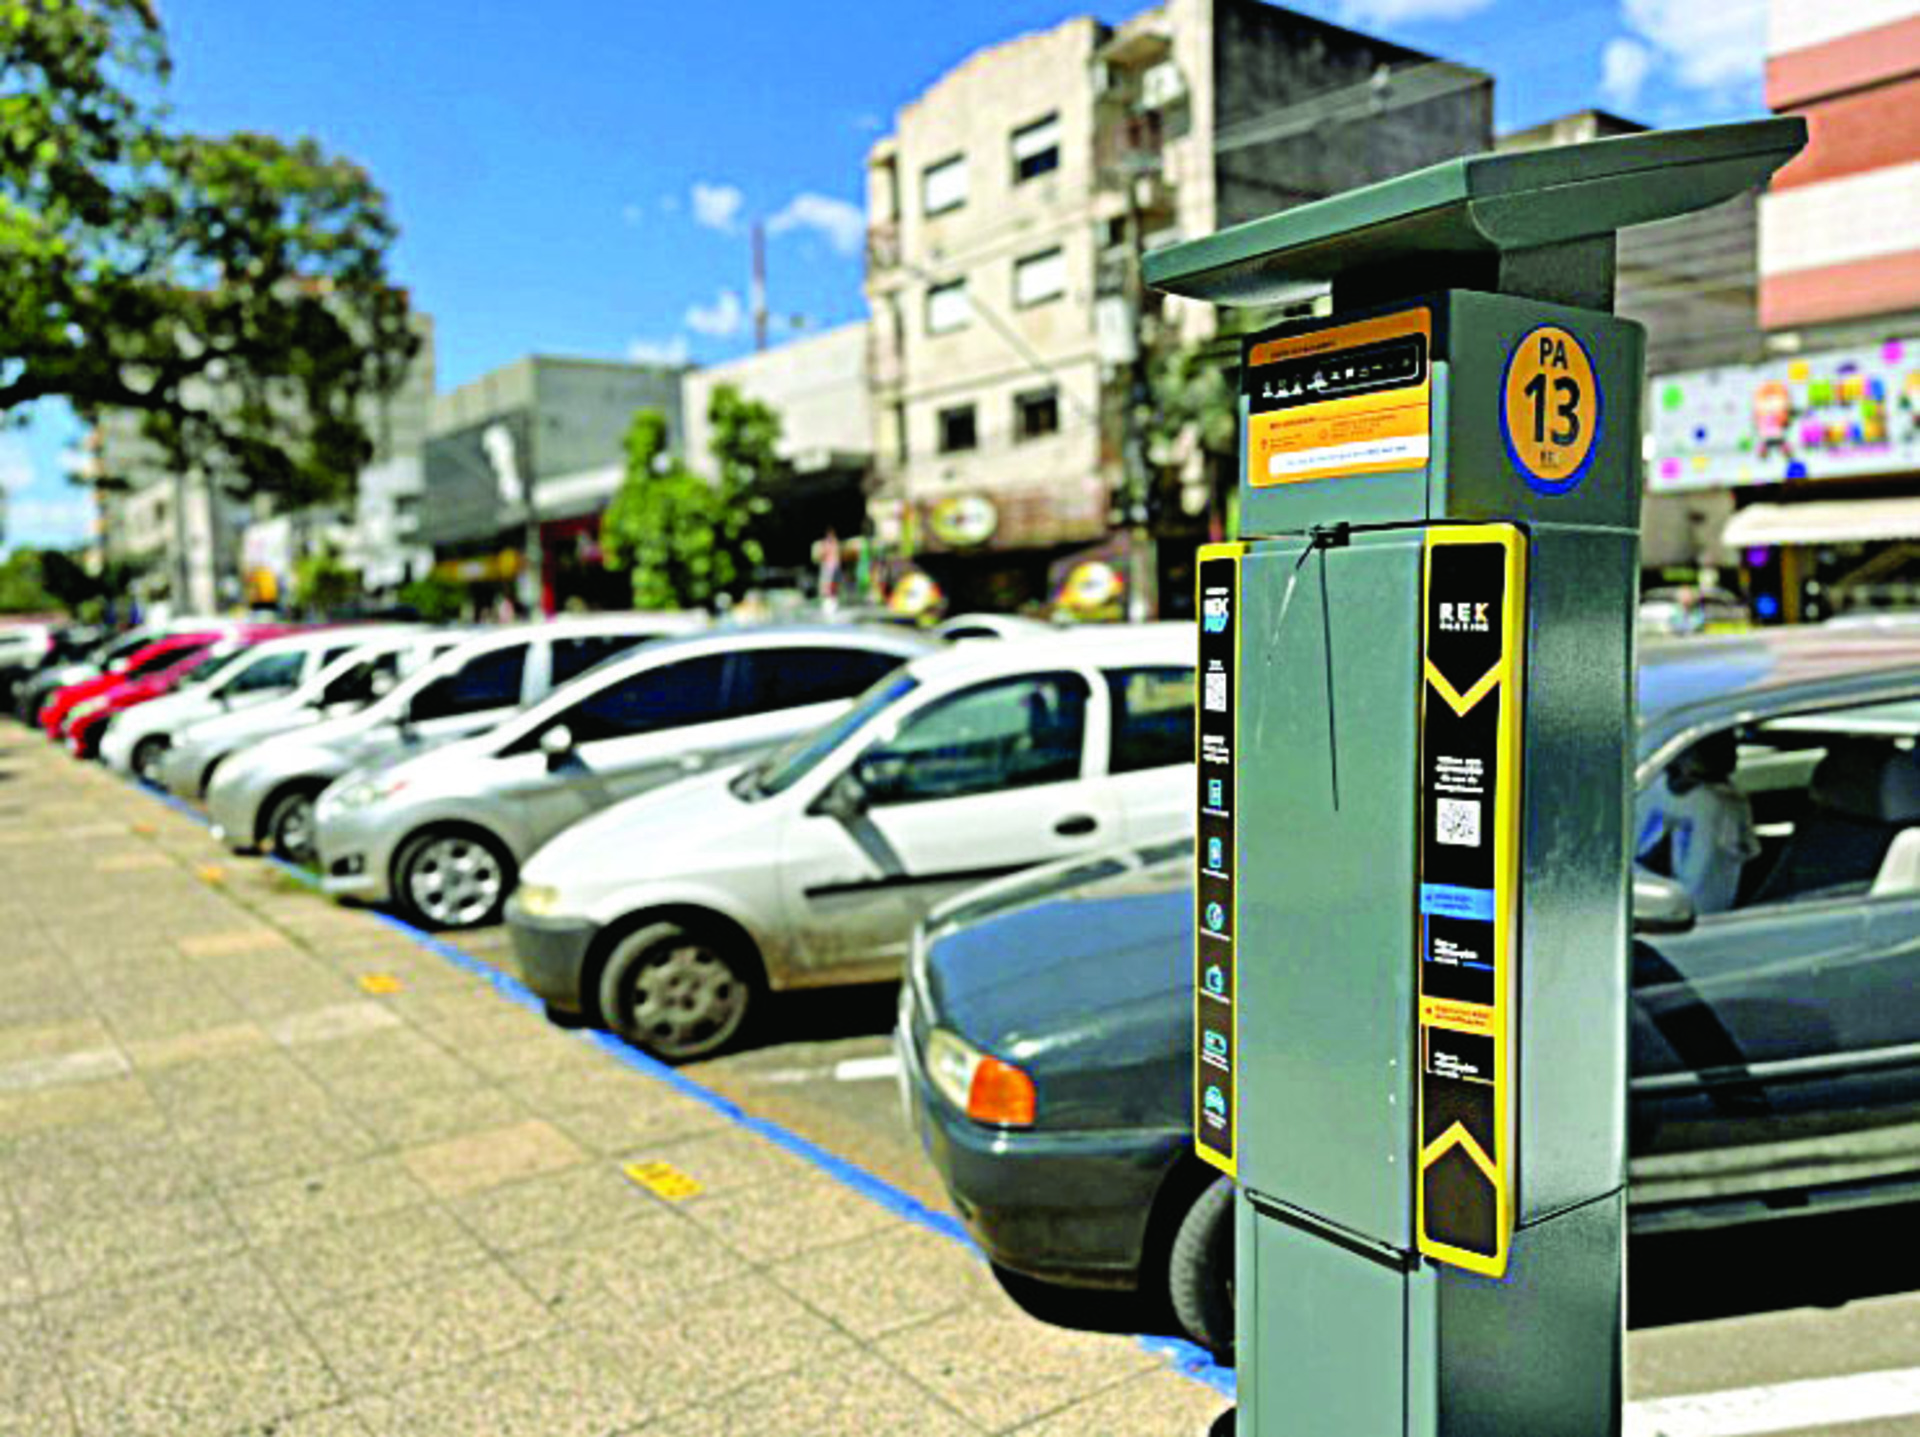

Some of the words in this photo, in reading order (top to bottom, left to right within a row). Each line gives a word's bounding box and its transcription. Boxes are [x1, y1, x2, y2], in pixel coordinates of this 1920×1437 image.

[1539, 337, 1568, 370] PA
[1524, 373, 1581, 447] 13
[1439, 602, 1489, 622] REK
